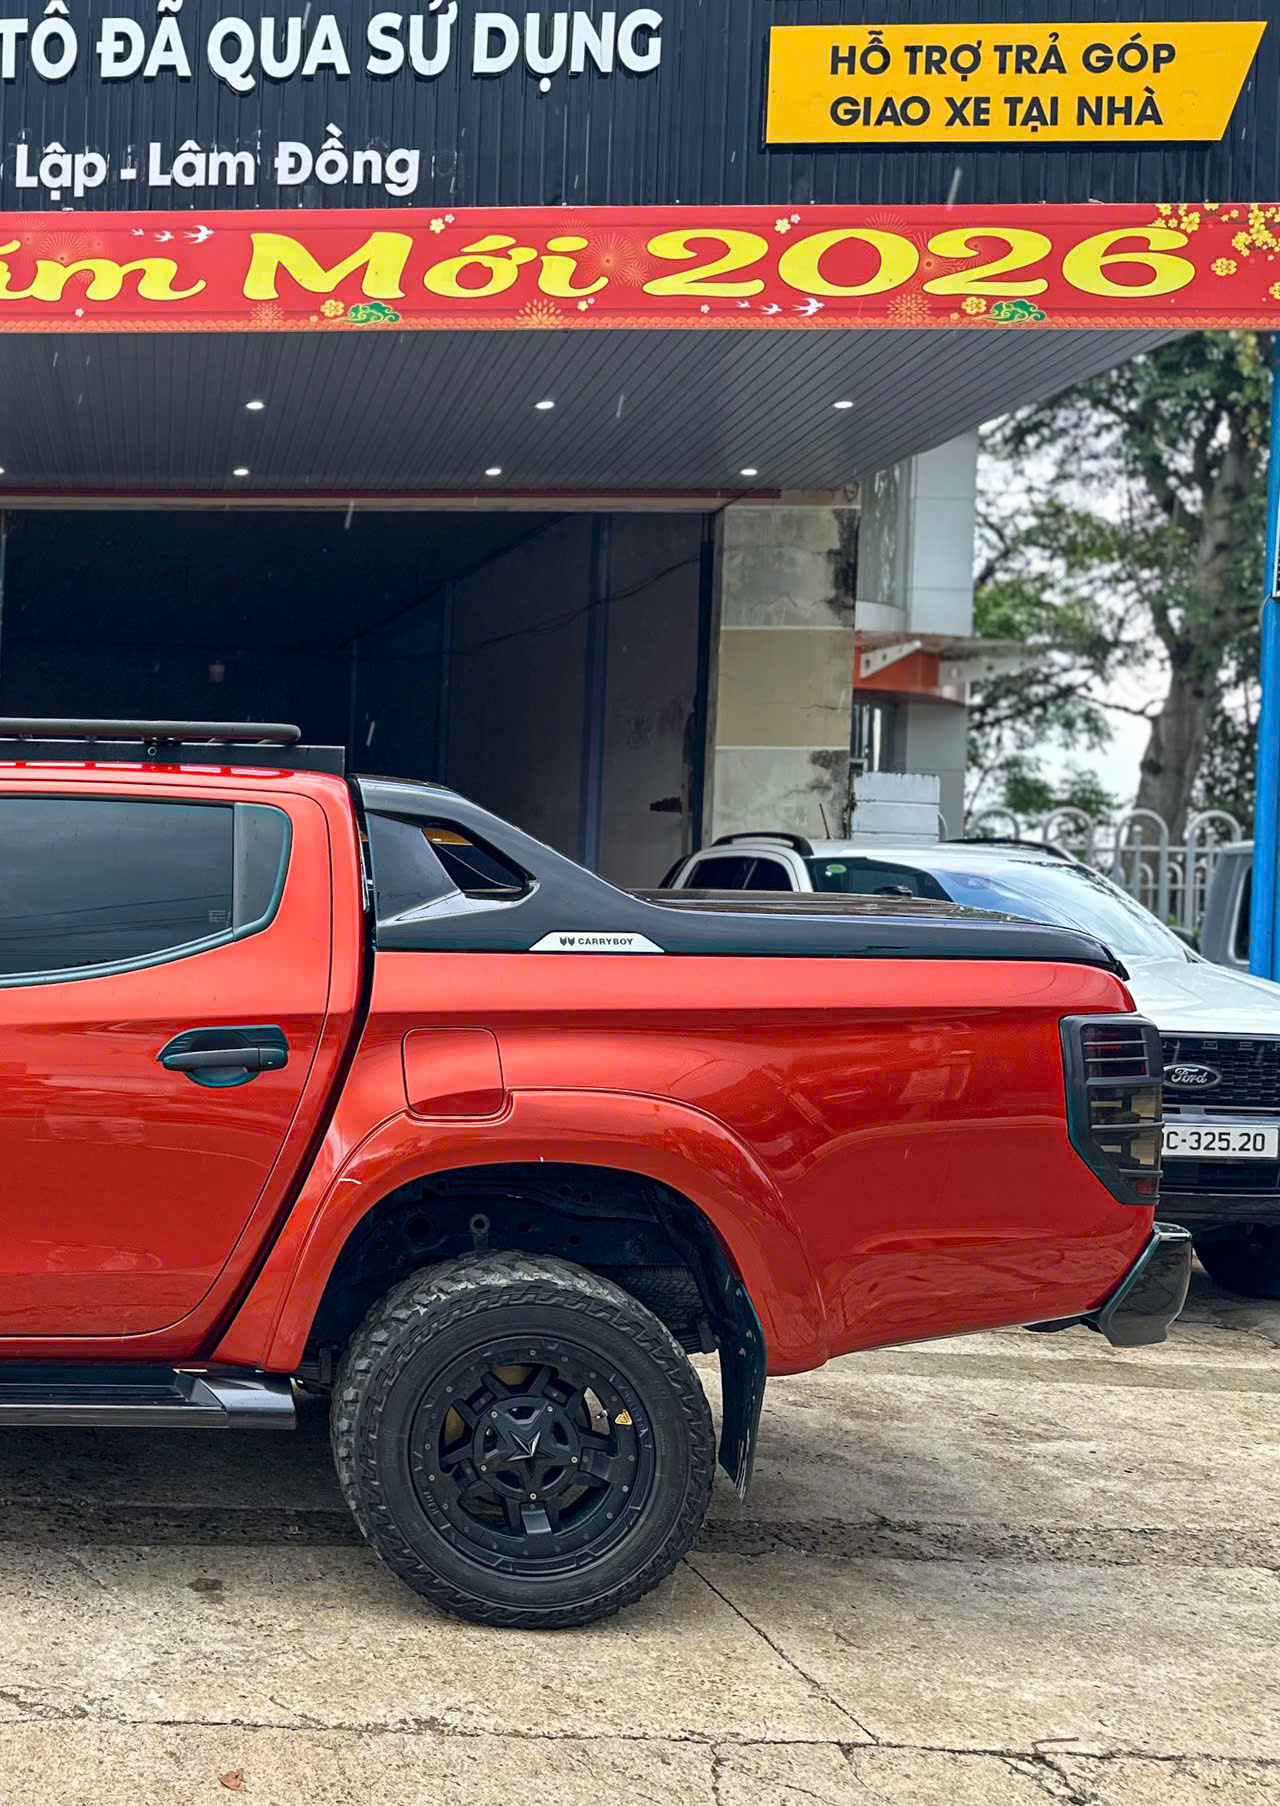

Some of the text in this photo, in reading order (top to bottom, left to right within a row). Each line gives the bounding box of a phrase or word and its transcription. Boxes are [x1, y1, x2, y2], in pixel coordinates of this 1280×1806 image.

[96, 0, 193, 79] ĐÃ
[207, 14, 352, 92] QUA
[473, 9, 663, 93] DỤNG
[830, 30, 1176, 82] HỖ TRỢ TRẢ GÓP
[830, 86, 1163, 133] GIAO XE TẠI NHÀ
[15, 141, 108, 201] Lập
[148, 139, 255, 187] Lâm
[274, 122, 420, 198] Đồng
[242, 231, 609, 300] Mới
[642, 227, 1197, 298] 2026
[577, 937, 634, 946] CARRYBOY
[1170, 1067, 1209, 1084] Ford
[1161, 1130, 1266, 1153] C-325.20
